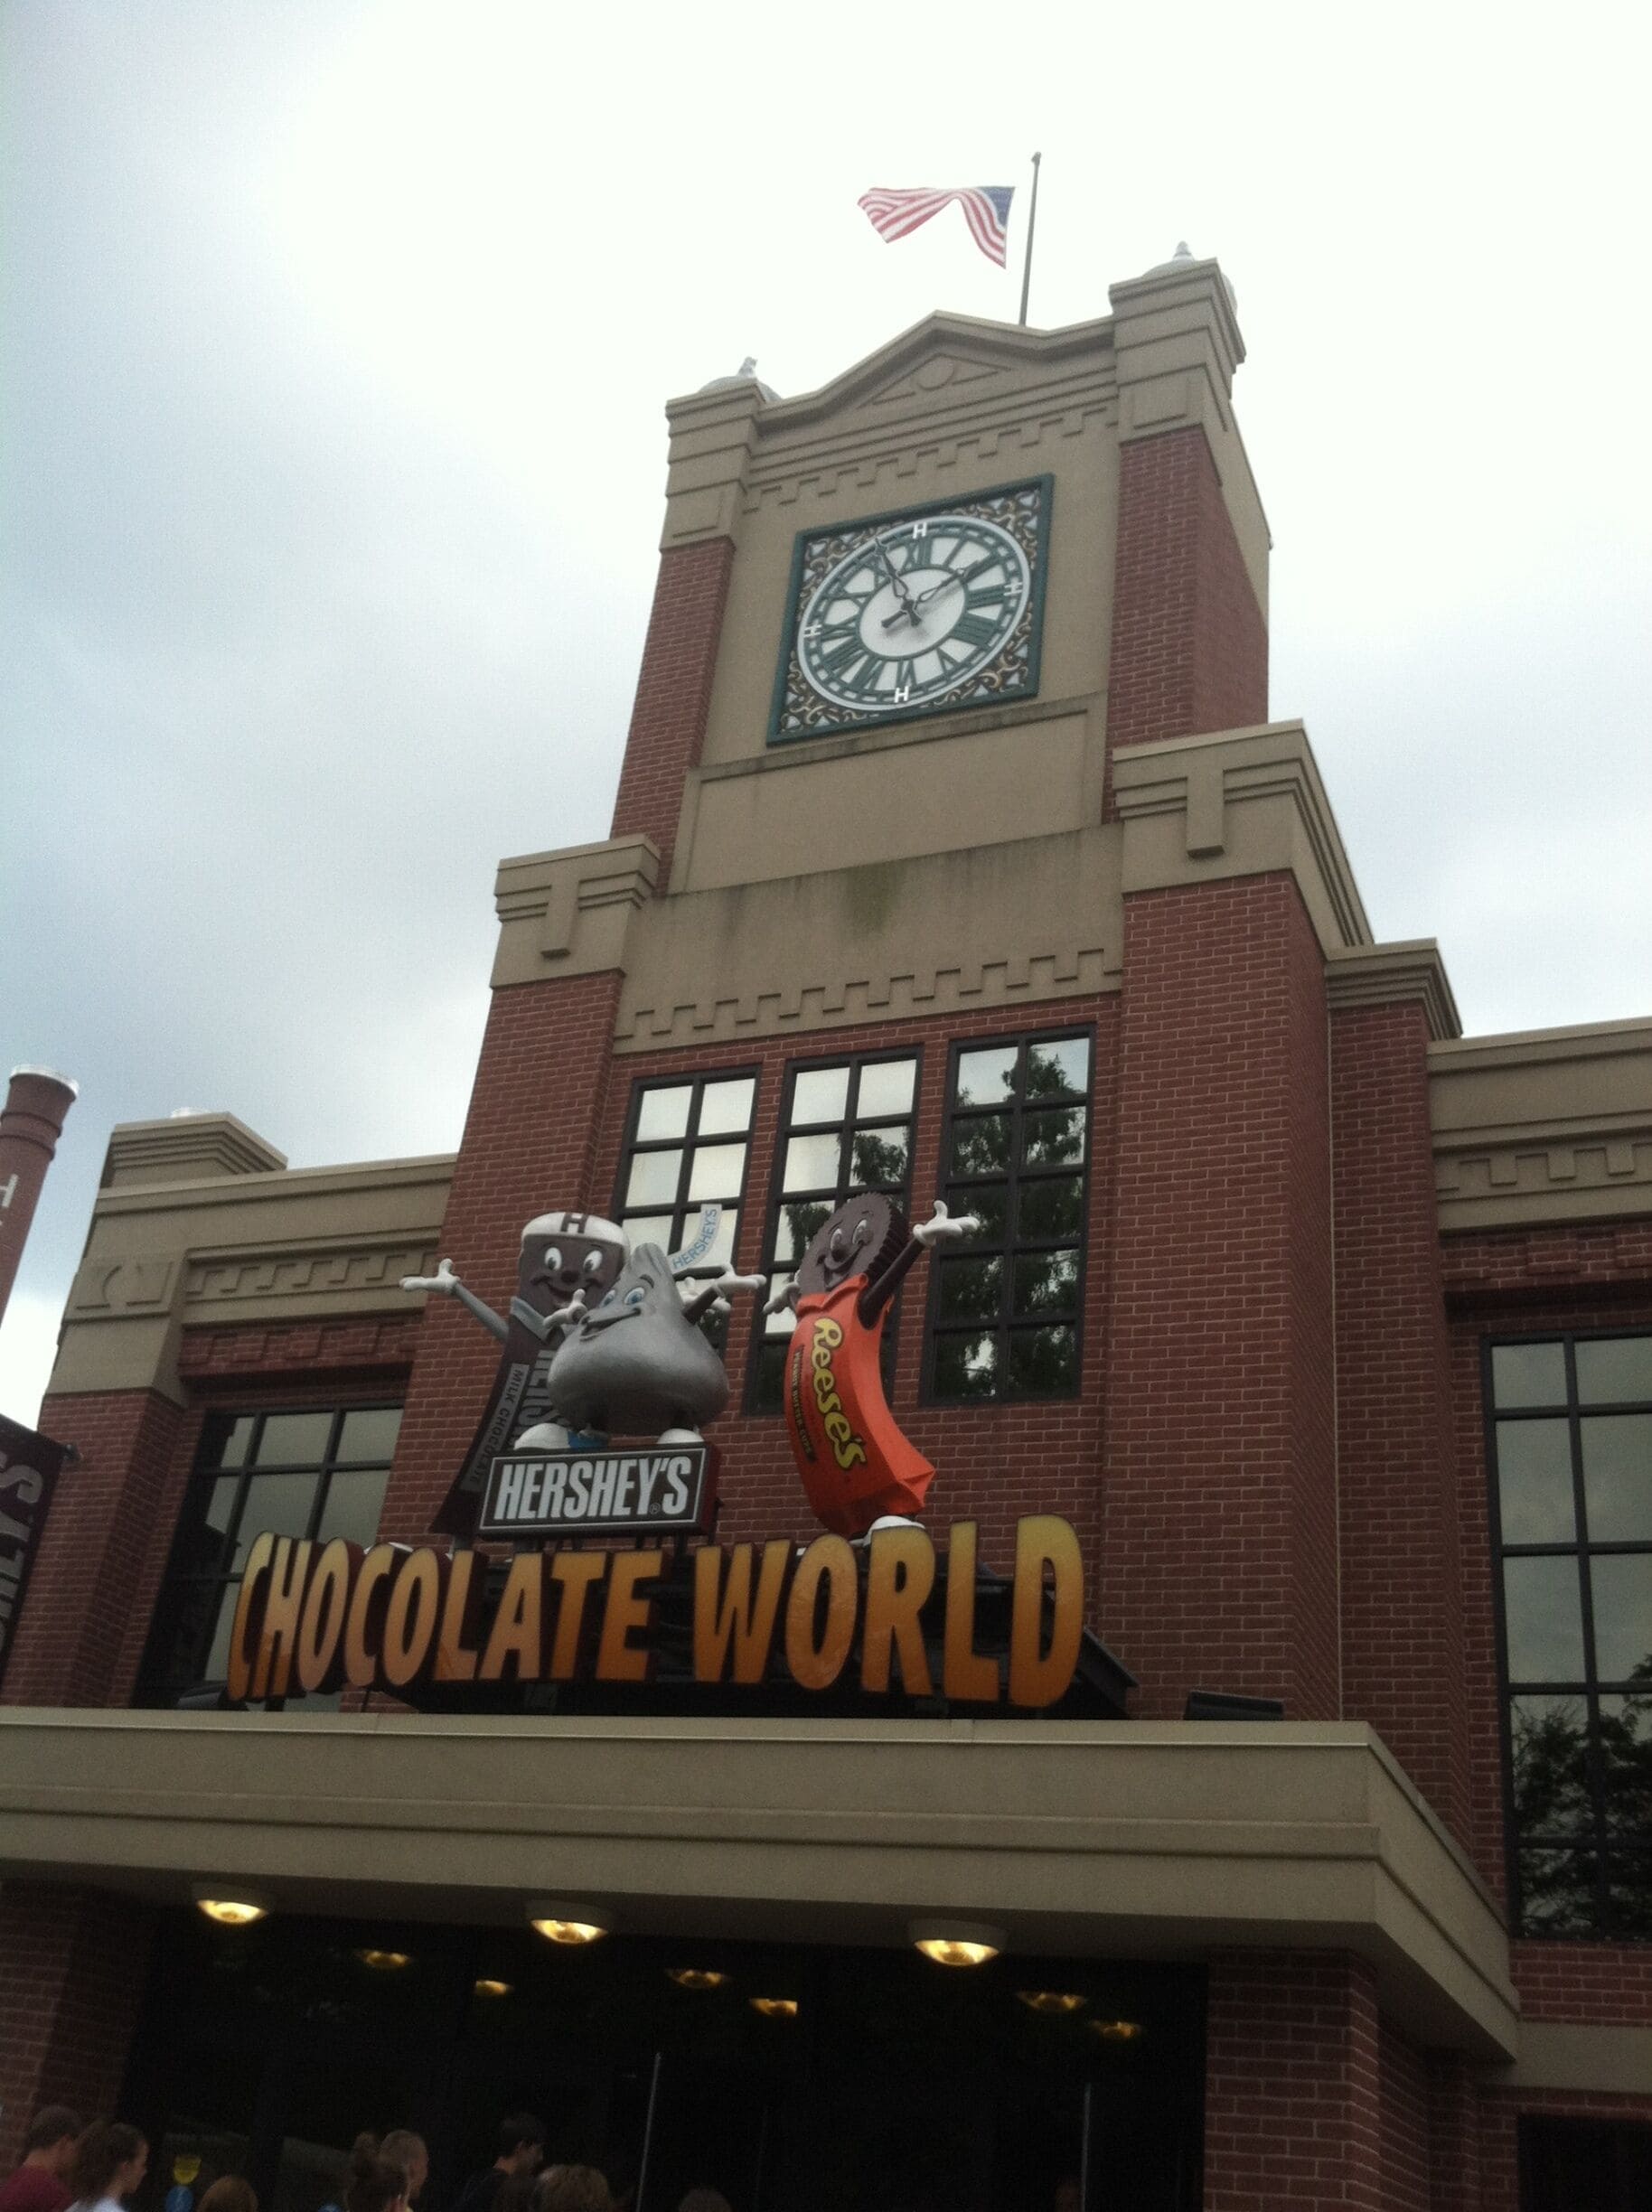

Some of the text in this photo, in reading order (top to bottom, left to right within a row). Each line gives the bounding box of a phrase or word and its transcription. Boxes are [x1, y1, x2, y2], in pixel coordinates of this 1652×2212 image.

[912, 521, 927, 539] H
[894, 686, 910, 704] H
[560, 1214, 588, 1234] H
[504, 1368, 522, 1403] MILK
[493, 1455, 693, 1522] HERSHEY'S
[227, 1531, 663, 1701] CHOCOLATE
[693, 1513, 1084, 1708] WORLD
